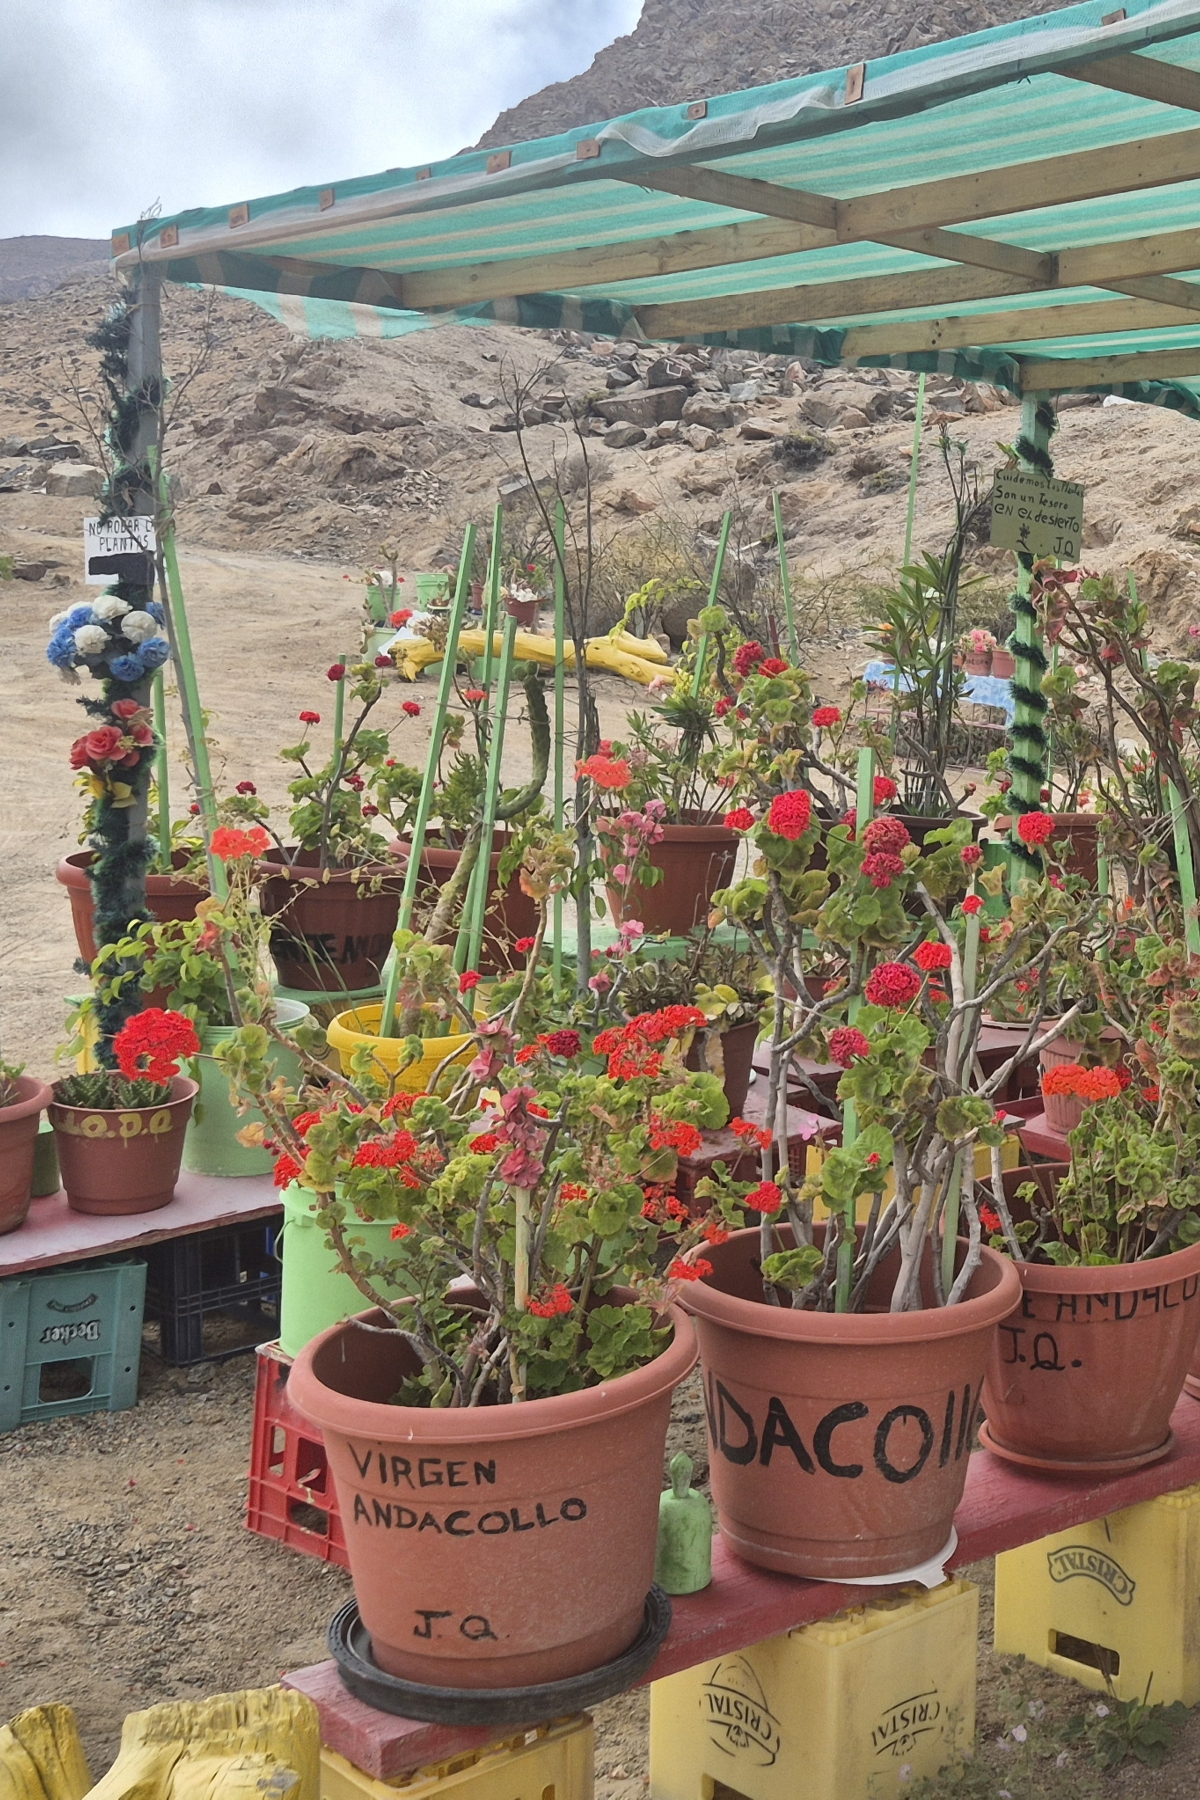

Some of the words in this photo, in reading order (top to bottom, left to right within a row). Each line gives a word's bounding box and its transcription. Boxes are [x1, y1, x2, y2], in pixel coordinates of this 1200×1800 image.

[994, 484, 1017, 499] Son
[1020, 494, 1035, 503] un
[1039, 492, 1069, 510] Tesoro
[100, 534, 149, 552] PLANTAS
[39, 1319, 101, 1345] Becker
[349, 1442, 497, 1489] VIRGEN
[353, 1493, 588, 1537] ANDACOLLO
[1053, 1551, 1129, 1595] CRISTAL
[704, 1692, 773, 1741] CRISTAL
